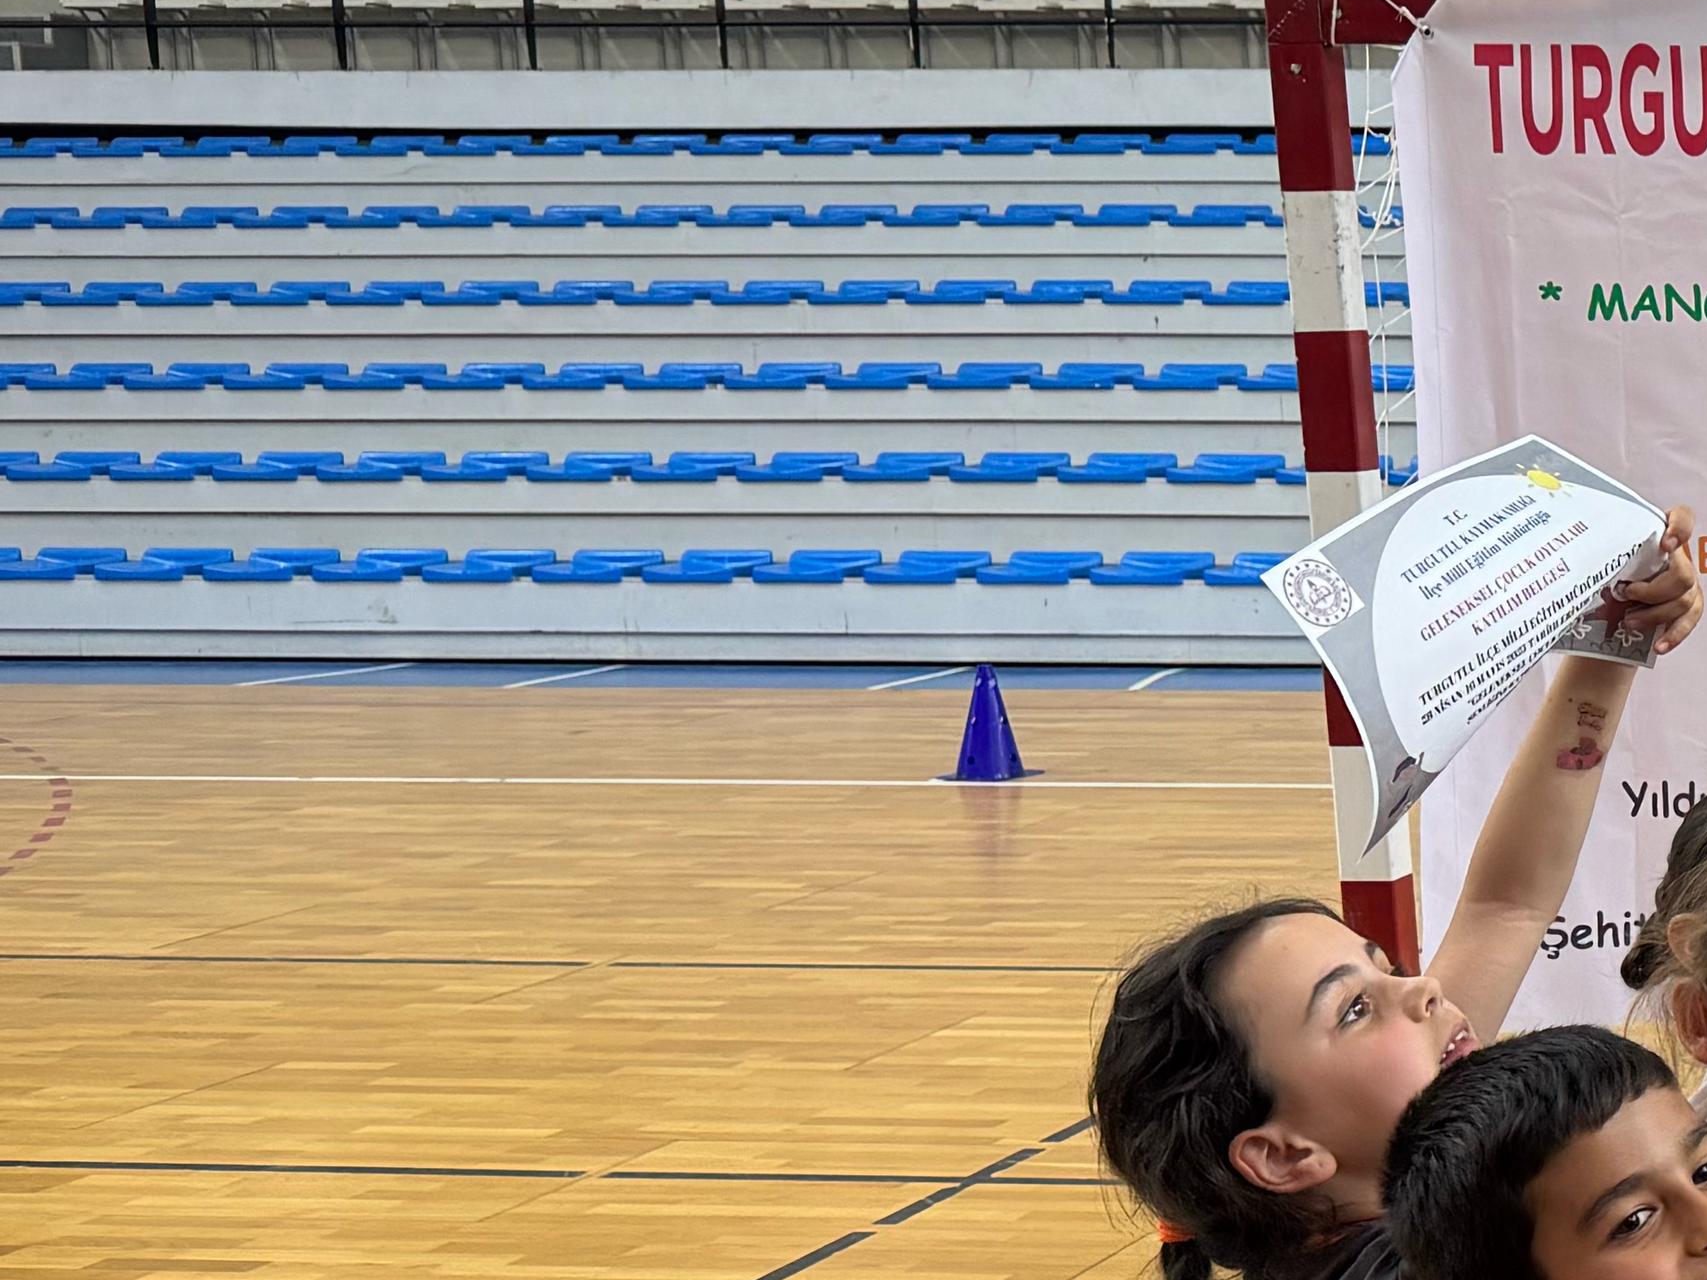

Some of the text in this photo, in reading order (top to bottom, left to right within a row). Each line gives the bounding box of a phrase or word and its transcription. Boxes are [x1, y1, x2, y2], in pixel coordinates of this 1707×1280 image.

[1420, 584, 1498, 643] GELENEKSEL
[1495, 553, 1539, 592] ÇOCUK
[1471, 594, 1523, 637] KATILIM
